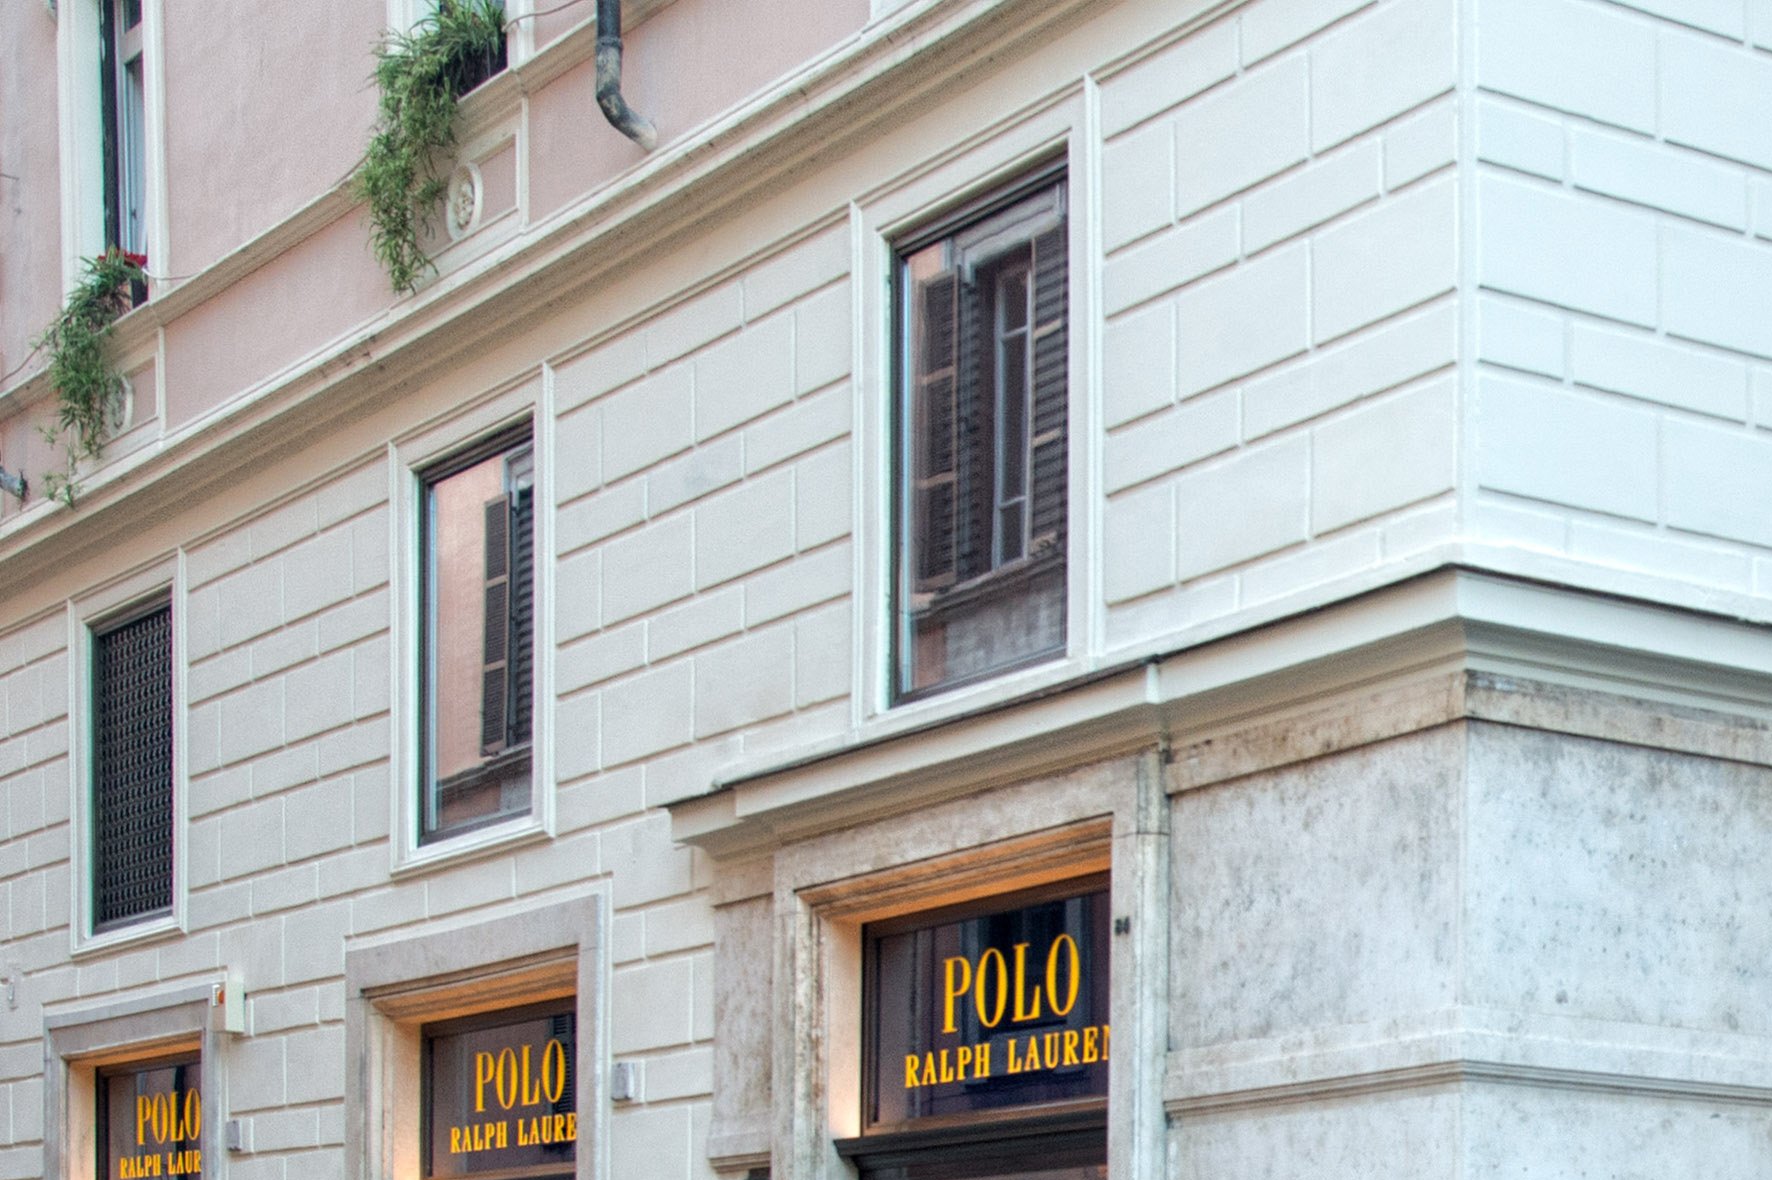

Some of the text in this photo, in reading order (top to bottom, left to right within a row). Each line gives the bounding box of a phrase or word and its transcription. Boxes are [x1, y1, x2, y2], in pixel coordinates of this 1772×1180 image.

[942, 933, 1081, 1034] POLO
[474, 1038, 566, 1113] POLO
[905, 1043, 991, 1088] RALPH
[136, 1087, 202, 1146] POLO
[449, 1112, 577, 1154] RALPH LAURE
[119, 1149, 202, 1180] RALPH LAUR
